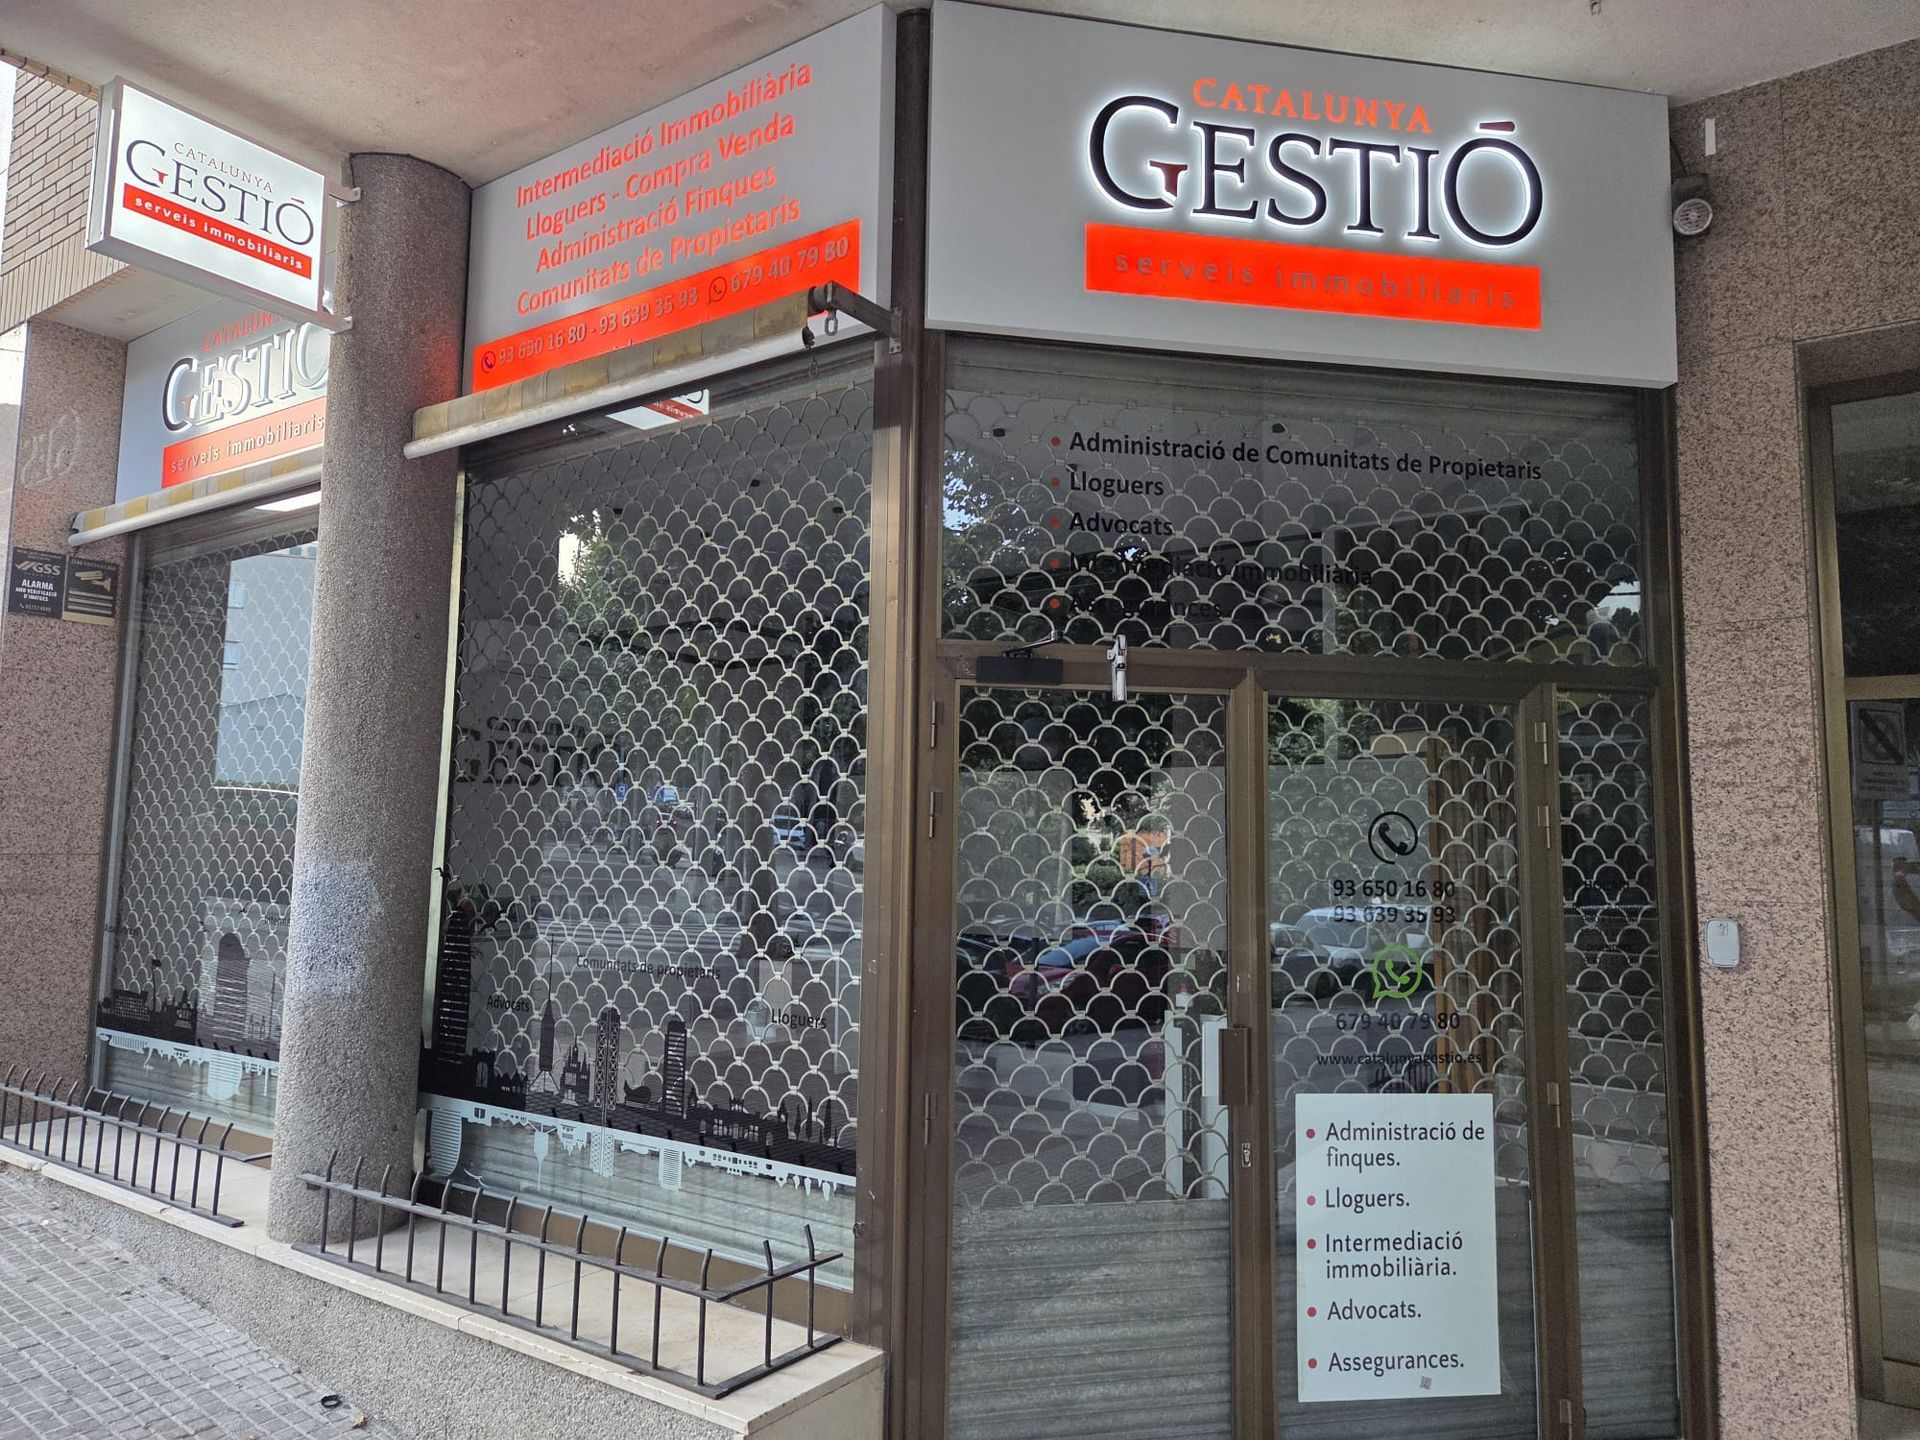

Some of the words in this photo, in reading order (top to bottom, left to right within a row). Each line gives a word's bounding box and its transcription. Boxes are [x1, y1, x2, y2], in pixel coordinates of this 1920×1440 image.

[1193, 78, 1432, 134] CATALUNYA
[517, 127, 654, 208] Intermediació
[660, 62, 812, 147] Immobiliària
[174, 142, 274, 193] CATALUNYA
[527, 191, 607, 240] Lloguers
[626, 150, 711, 199] Compra
[718, 112, 795, 161] Venda
[1089, 95, 1544, 248] GESTIÓ
[536, 195, 679, 273] Administració
[685, 164, 777, 217] Finques
[134, 196, 197, 228] serveis
[203, 221, 303, 270] immobiliaris
[518, 259, 631, 316] Comunitats
[637, 246, 664, 277] de
[670, 196, 801, 265] Propietaris
[1115, 251, 1254, 285] serveis
[1275, 265, 1515, 310] immobiliaris
[499, 348, 514, 366] 93
[518, 338, 543, 359] 650
[548, 331, 565, 351] 16
[567, 323, 587, 344] 80
[599, 314, 618, 335] 93
[621, 303, 650, 327] 639
[655, 295, 674, 317] 35
[679, 287, 698, 309] 93
[730, 264, 763, 293] 679
[768, 255, 791, 279] 40
[798, 246, 820, 271] 79
[824, 236, 850, 261] 80
[170, 445, 221, 474] serveis
[226, 413, 325, 457] immobiliaris
[1069, 431, 1226, 460] Administració
[1233, 442, 1259, 463] de
[1266, 445, 1390, 471] Comunitats
[1396, 453, 1422, 473] de
[1429, 455, 1542, 480] Propietaris
[1069, 471, 1165, 497] Lloguers
[1069, 511, 1174, 537] Advocats
[32, 562, 61, 576] GSS
[21, 578, 54, 591] ALARMA
[1332, 879, 1356, 897] 93
[1362, 879, 1398, 898] 650
[1404, 880, 1426, 898] 16
[1432, 880, 1456, 899] 80
[1332, 905, 1356, 923] 93
[1362, 905, 1398, 924] 639
[1404, 906, 1427, 924] 35
[1432, 906, 1456, 924] 93
[576, 954, 639, 975] Comunitats
[639, 960, 654, 975] de
[658, 962, 721, 983] propietaris
[486, 995, 530, 1014] Advocats
[771, 1008, 827, 1032] Lloguers
[1335, 1012, 1371, 1030] 679
[1377, 1012, 1400, 1030] 40
[1407, 1012, 1431, 1030] 79
[1437, 1012, 1460, 1030] 80
[1325, 1120, 1457, 1142] Administració
[1462, 1120, 1486, 1141] de
[1326, 1146, 1401, 1173] finques.
[1325, 1187, 1411, 1214] Lloguers.
[1326, 1230, 1463, 1252] Intermediació
[1326, 1257, 1458, 1279] immobiliària.
[1327, 1299, 1422, 1321] Advocats.
[1328, 1351, 1465, 1377] Assegurances.
